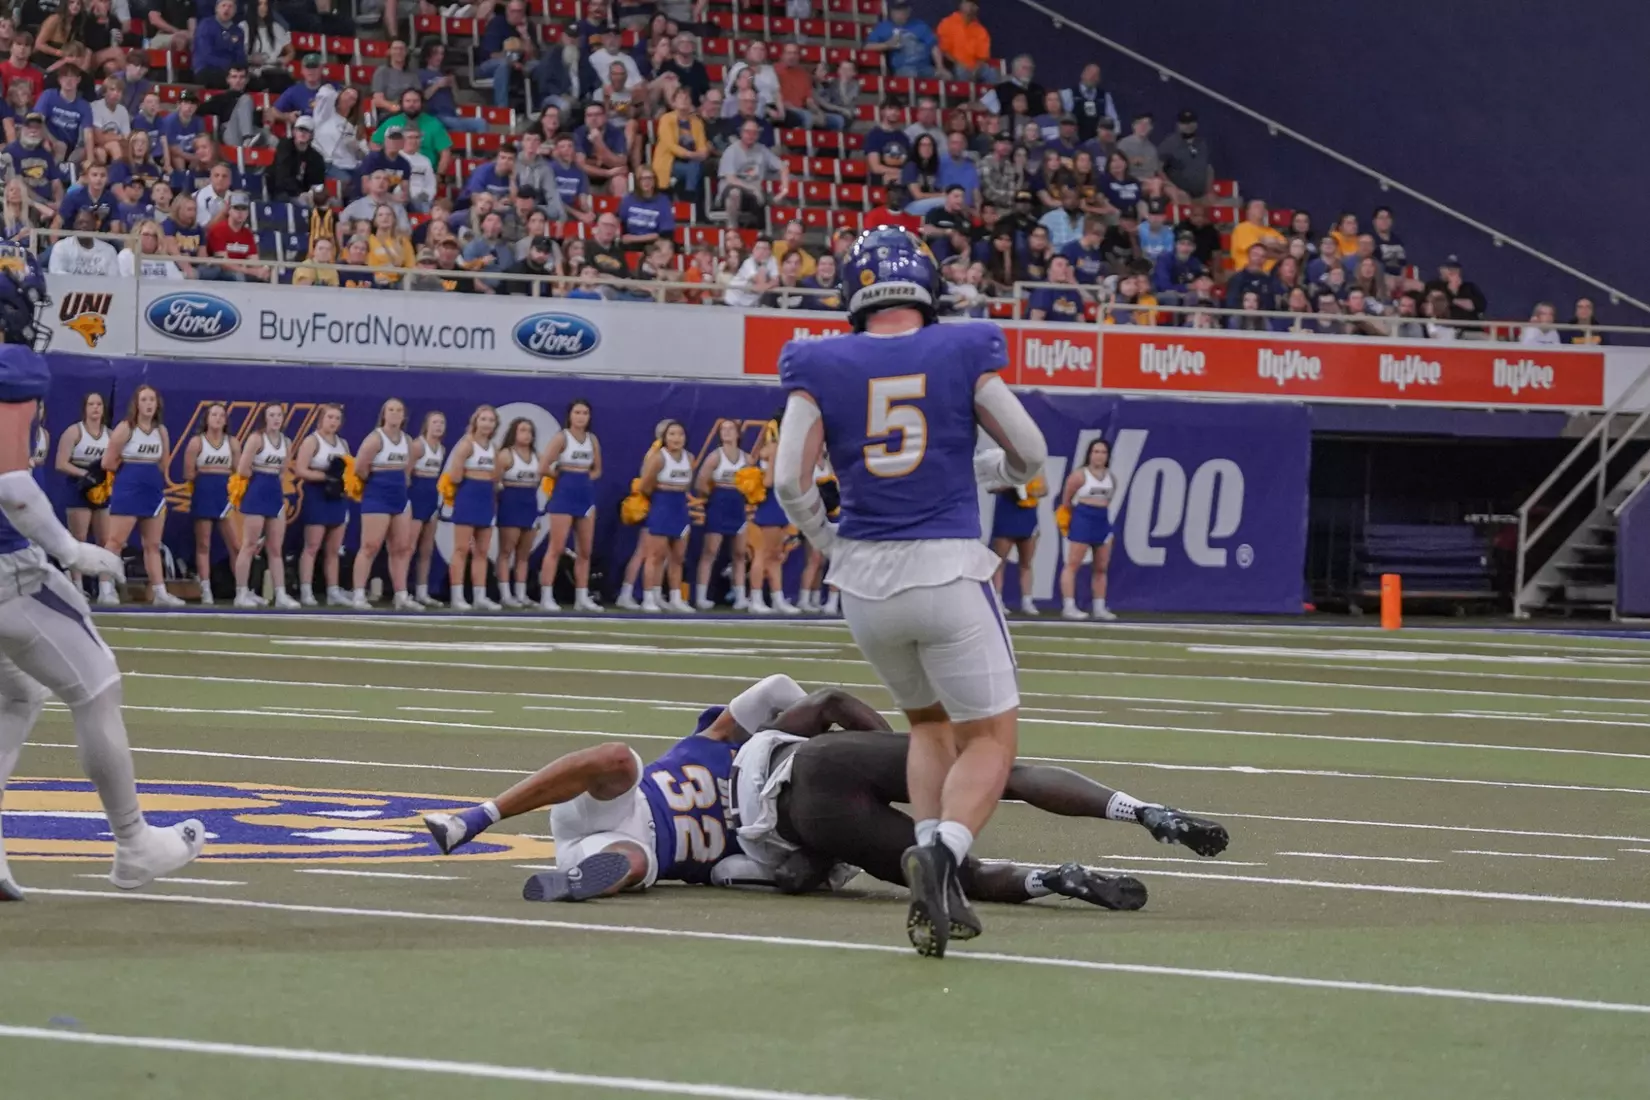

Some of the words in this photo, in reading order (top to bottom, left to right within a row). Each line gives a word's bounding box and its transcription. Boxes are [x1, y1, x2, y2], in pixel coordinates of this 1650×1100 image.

[59, 292, 113, 321] UNI
[861, 286, 918, 300] PANTHERS
[163, 300, 222, 334] Ford
[259, 309, 496, 349] BuyFordNow.com
[528, 319, 583, 351] Ford
[864, 374, 927, 478] 5
[84, 446, 104, 457] UN
[137, 444, 160, 454] UNI
[651, 764, 726, 862] 32
